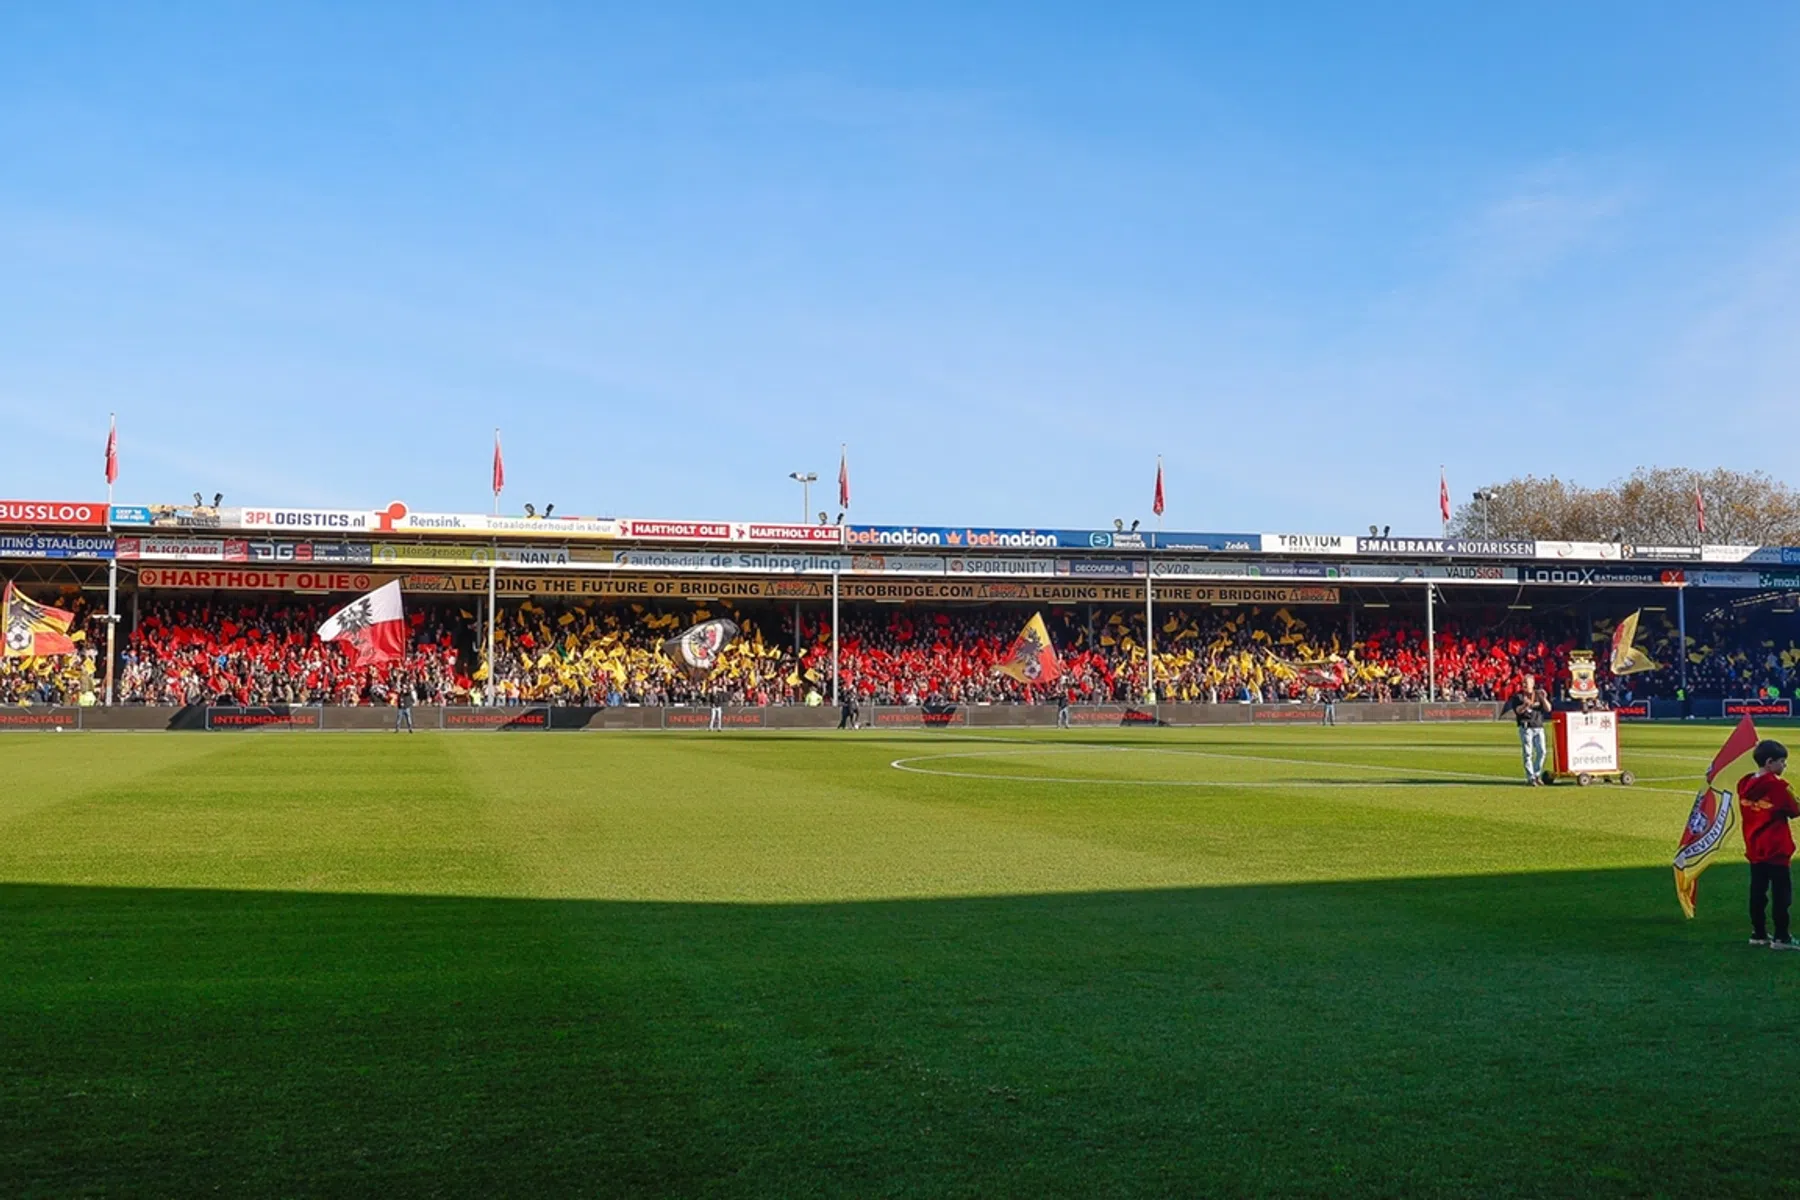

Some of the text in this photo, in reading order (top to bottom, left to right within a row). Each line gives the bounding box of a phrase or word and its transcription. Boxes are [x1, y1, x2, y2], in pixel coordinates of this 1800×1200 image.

[0, 505, 91, 521] BUSSLOO
[245, 512, 365, 527] 3PLOGISTICS.nl
[487, 519, 574, 531] Totaalonderhoud
[588, 523, 612, 532] kleur
[635, 524, 727, 536] HARTHOLT OLIE
[751, 527, 839, 539] HARTHOLT OLIE
[847, 527, 940, 544] betnation
[967, 530, 1057, 547] betnation
[37, 539, 115, 550] STAALBOUW
[1279, 535, 1341, 547] TRIVIUM
[1359, 539, 1443, 553] SMALBRAAK
[1458, 542, 1533, 555] NOTARISSEN
[162, 546, 218, 554] KRAMER
[710, 554, 732, 567] de
[967, 560, 1046, 573] SPORTUNITY
[1167, 564, 1190, 575] VDR
[161, 571, 350, 590] HARTHOLT OLIE
[461, 578, 760, 595] LEADING THE FUTURE OF BRIDGING
[1034, 587, 1097, 599] LEADING
[1102, 587, 1131, 599] THE
[1199, 589, 1214, 600] OF
[1219, 588, 1286, 601] BRIDGING
[213, 715, 314, 725] INTERMONTAGE
[447, 714, 544, 725] INTERMONTAGE
[878, 713, 963, 722] INTERMONTAGE
[1572, 754, 1612, 767] present
